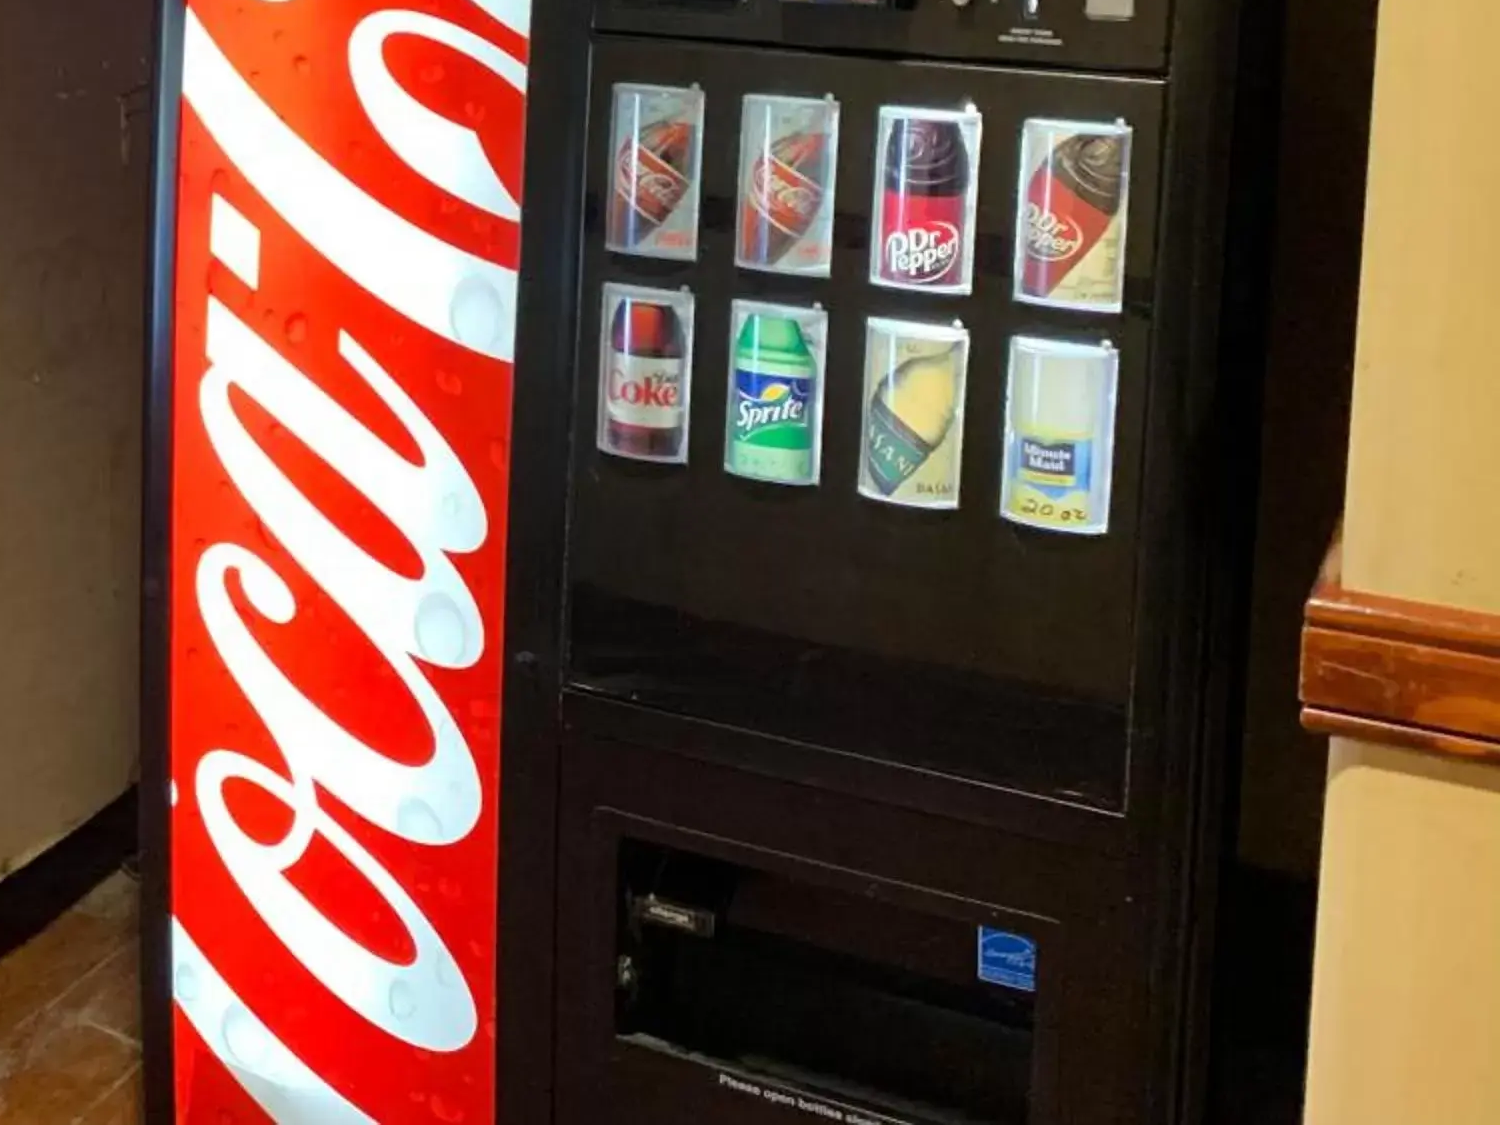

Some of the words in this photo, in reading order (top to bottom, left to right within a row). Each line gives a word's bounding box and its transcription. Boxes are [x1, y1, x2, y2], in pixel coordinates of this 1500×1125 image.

[909, 228, 941, 249] Dr
[887, 231, 957, 276] Pepper
[608, 368, 678, 407] Coke
[736, 394, 803, 431] Sprite
[1024, 442, 1072, 461] Minute
[1028, 456, 1066, 472] Maid
[1021, 498, 1054, 517] 20
[1060, 507, 1087, 522] oz
[719, 1073, 762, 1097] Please
[763, 1089, 796, 1108] open
